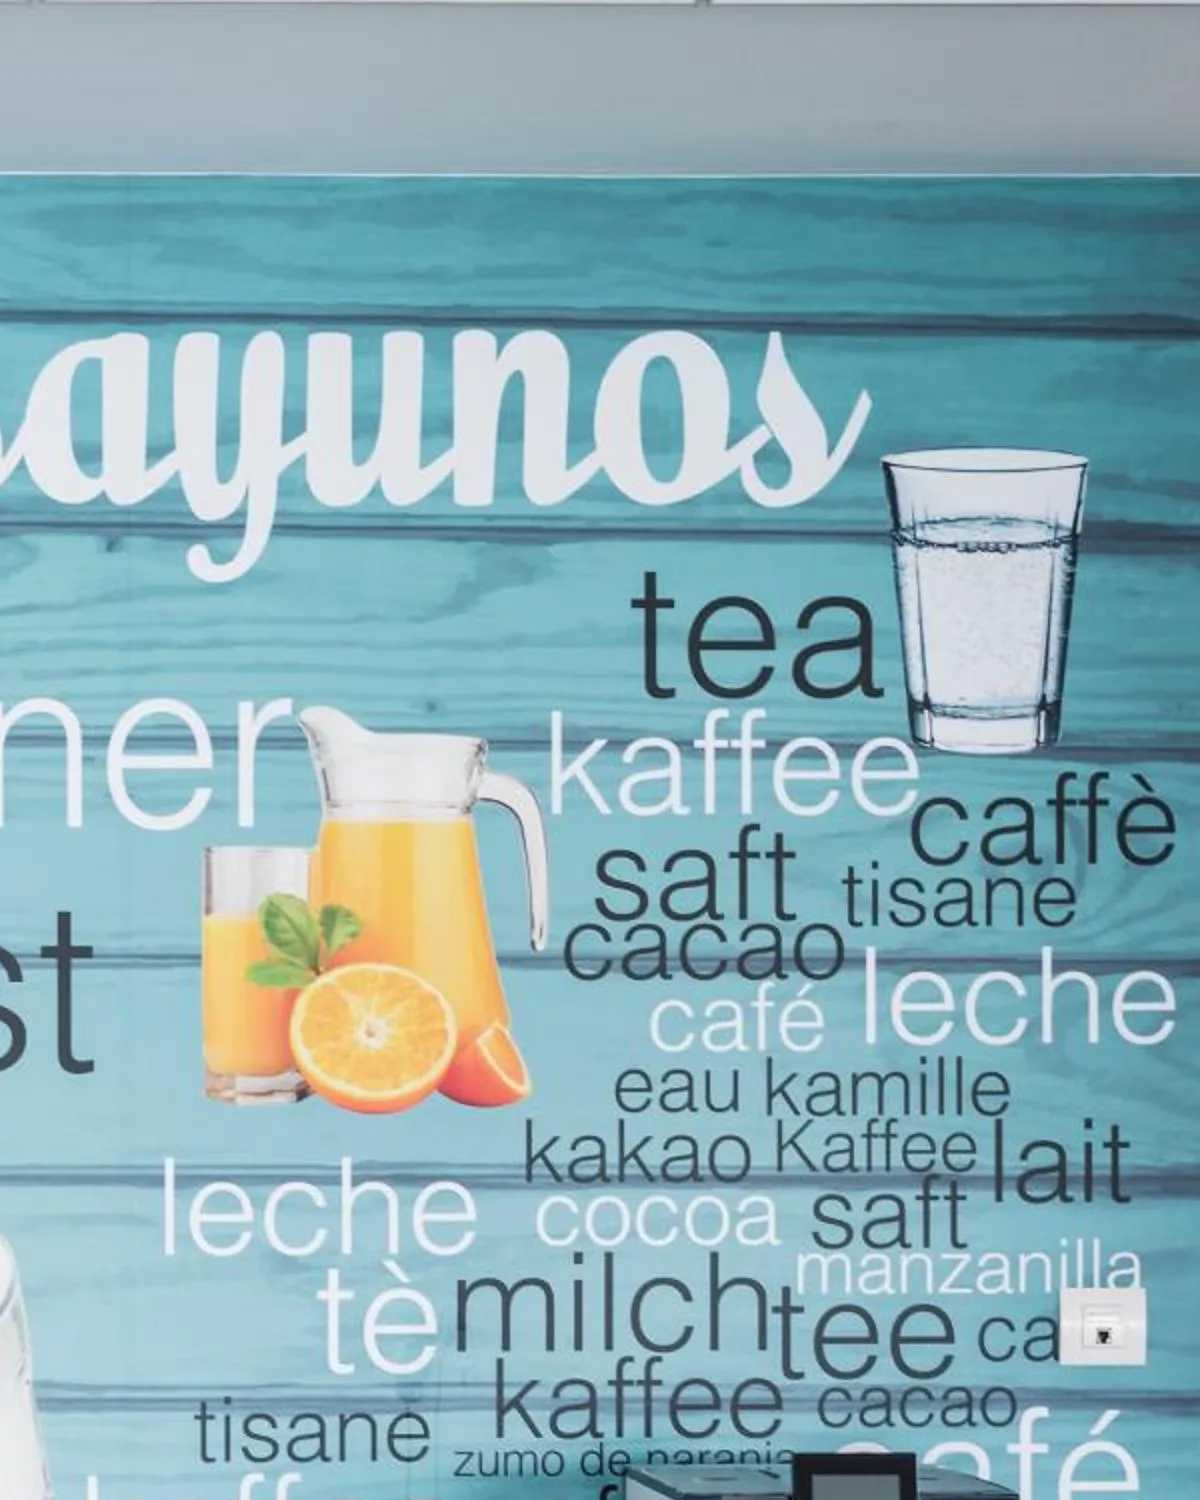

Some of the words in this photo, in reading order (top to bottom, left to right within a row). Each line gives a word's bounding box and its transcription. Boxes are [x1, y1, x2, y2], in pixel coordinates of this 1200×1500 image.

[631, 571, 885, 700] tea
[550, 708, 921, 817] kaffee
[910, 771, 1178, 868] caffè
[594, 823, 797, 922] saft
[841, 861, 1078, 928] tisane
[563, 922, 846, 982] cacao
[649, 982, 826, 1054] café
[864, 945, 1178, 1046] leche
[614, 1066, 741, 1114] eau
[765, 1056, 1012, 1117] kamille
[525, 1118, 752, 1184] kakao
[775, 1118, 978, 1174] Kaffee
[993, 1118, 1132, 1204] lait
[163, 1156, 479, 1258] leche
[534, 1193, 782, 1247] cocoa
[810, 1180, 970, 1250] saft
[456, 1250, 769, 1353] milch
[796, 1237, 1144, 1296] manzanilla
[316, 1259, 440, 1376] tè
[771, 1284, 956, 1380] tee
[193, 1397, 432, 1464] tisane
[495, 1356, 784, 1440] kaffee
[817, 1385, 1018, 1428] cacao
[453, 1448, 565, 1478] zumo
[579, 1442, 630, 1478] de
